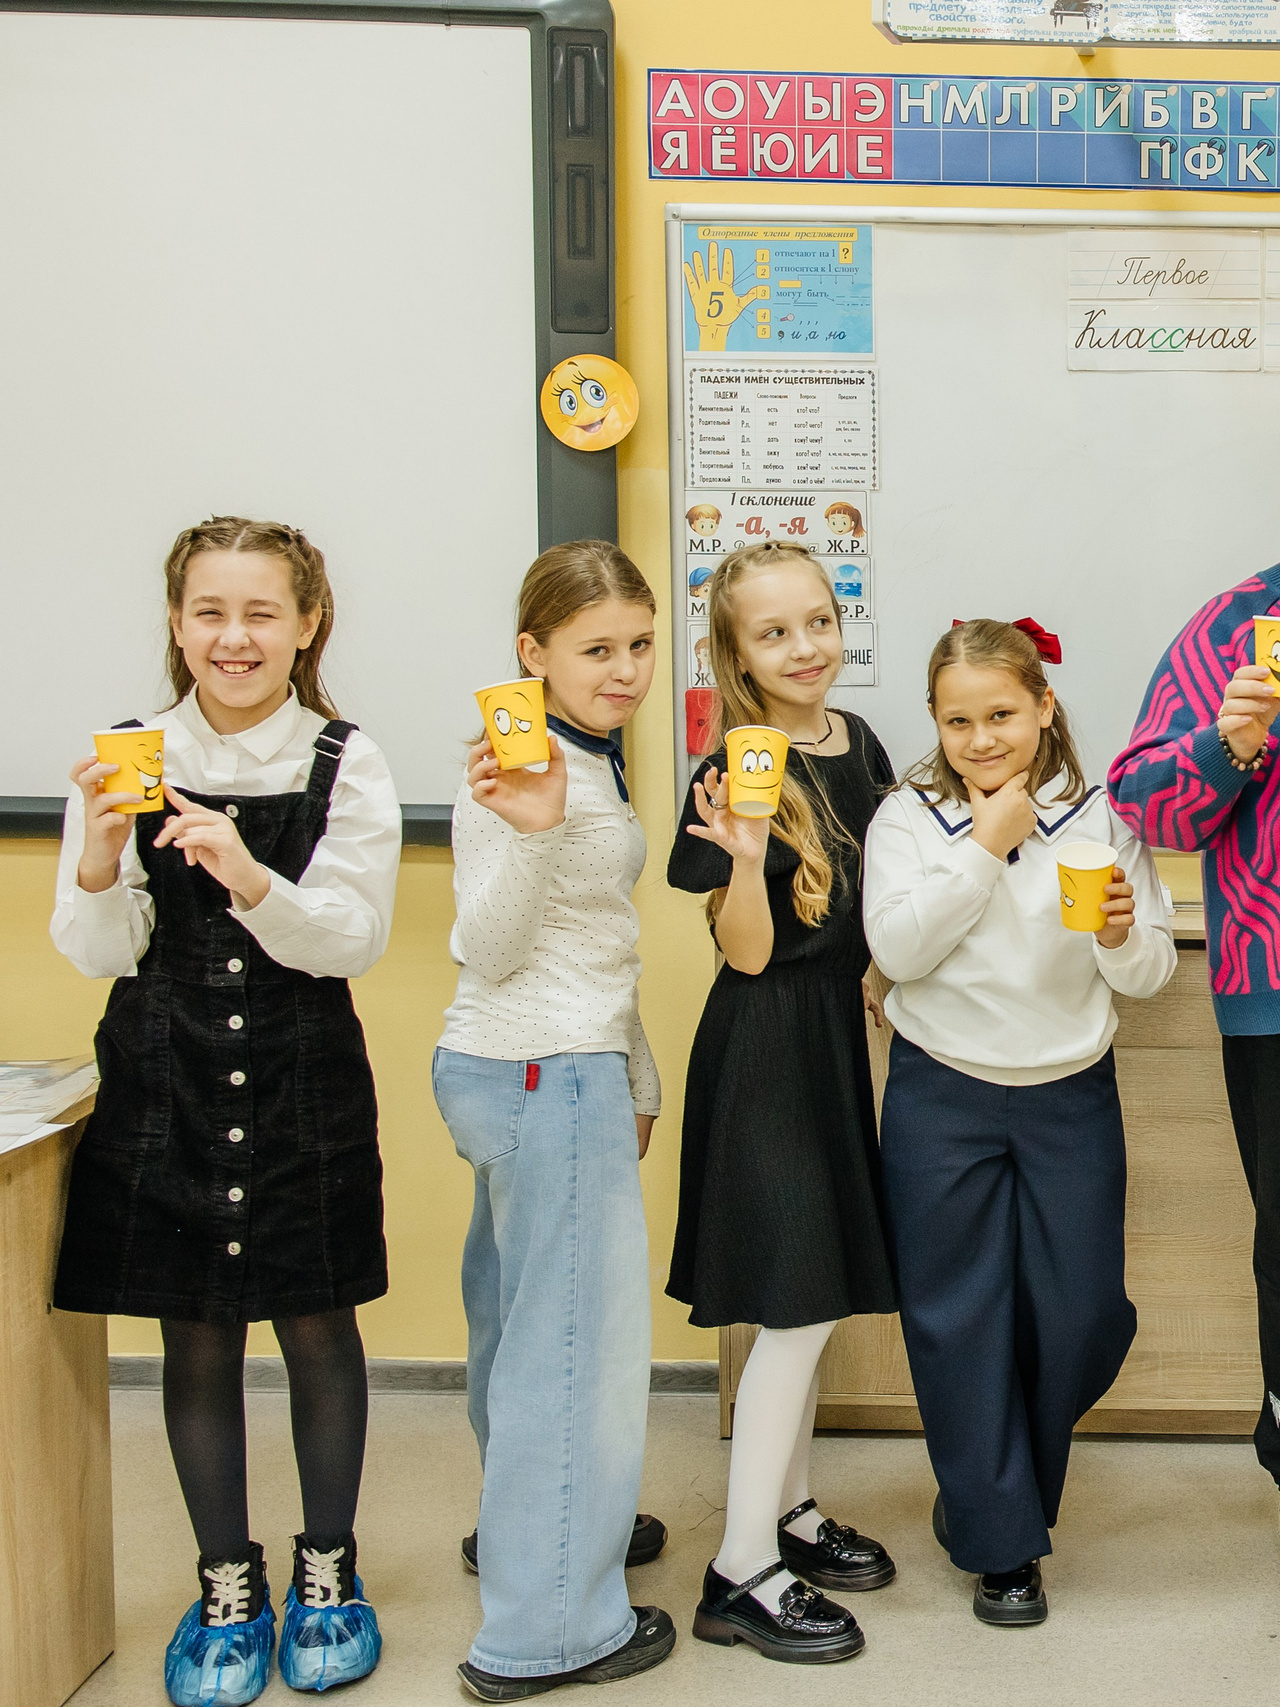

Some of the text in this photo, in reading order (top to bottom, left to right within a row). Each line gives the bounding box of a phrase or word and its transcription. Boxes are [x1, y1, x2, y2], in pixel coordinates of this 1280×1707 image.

[929, 13, 977, 22] свойств
[656, 79, 695, 118] А
[703, 79, 745, 120] О
[754, 81, 790, 120] У
[803, 82, 841, 121] Ы
[855, 82, 886, 122] Э
[900, 84, 933, 124] Н
[942, 85, 988, 124] М
[995, 86, 1029, 125] Л
[1051, 87, 1079, 126] Р
[1095, 85, 1130, 128] Й
[1143, 91, 1171, 129] Б
[1191, 92, 1219, 130] В
[1240, 93, 1267, 131] Г
[659, 131, 690, 171] Я
[711, 126, 738, 173] Ё
[752, 132, 796, 174] Ю
[803, 133, 839, 174] И
[856, 135, 883, 175] Е
[1139, 141, 1171, 180] П
[1183, 141, 1224, 181] Ф
[1236, 143, 1269, 181] К
[702, 229, 855, 240] Однородные члены предложения
[1117, 257, 1210, 297] Первое
[776, 291, 802, 299] могут
[707, 291, 725, 319] 5
[1074, 309, 1257, 349] Классная
[700, 375, 866, 386] ПАДЕЖИ ИМЁН СУЩЕСТВИТЕЛЬНЫХ
[714, 391, 739, 400] ПАДЕЖИ
[739, 493, 817, 507] склонение
[778, 516, 809, 536] -я
[689, 539, 726, 553] М.Р.
[826, 539, 865, 554] Ж.Р.
[843, 649, 872, 665] ОНЦЕ
